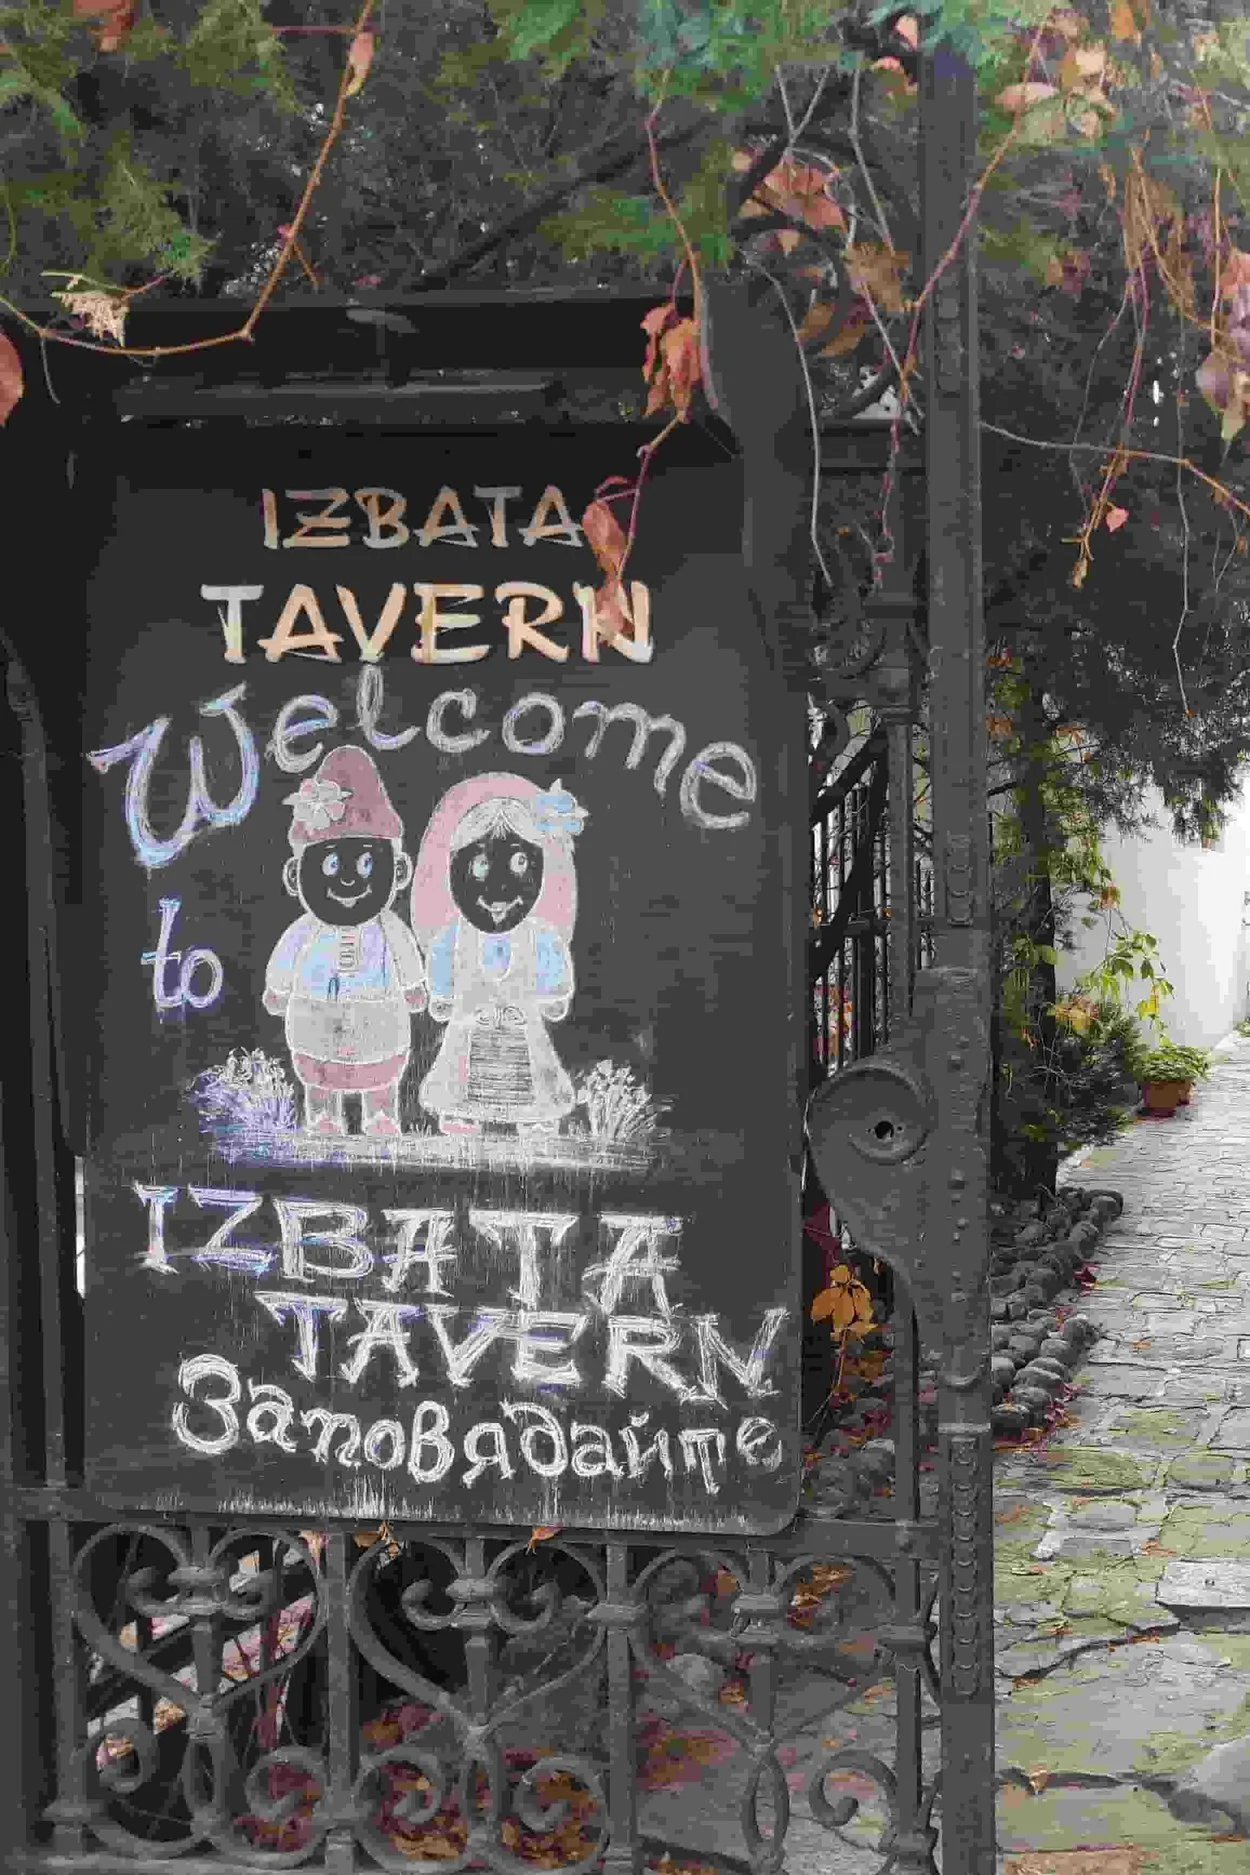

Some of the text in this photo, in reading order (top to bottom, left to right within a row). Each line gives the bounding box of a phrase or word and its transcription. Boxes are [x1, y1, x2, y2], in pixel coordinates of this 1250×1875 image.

[260, 486, 586, 549] IZBATA
[200, 581, 655, 664] TAVERN
[87, 662, 757, 868] Welcome
[140, 898, 224, 1012] to
[130, 1183, 684, 1316] IZBATA
[254, 1291, 789, 1408] TAVERN
[171, 1353, 785, 1494] Заповядайте
